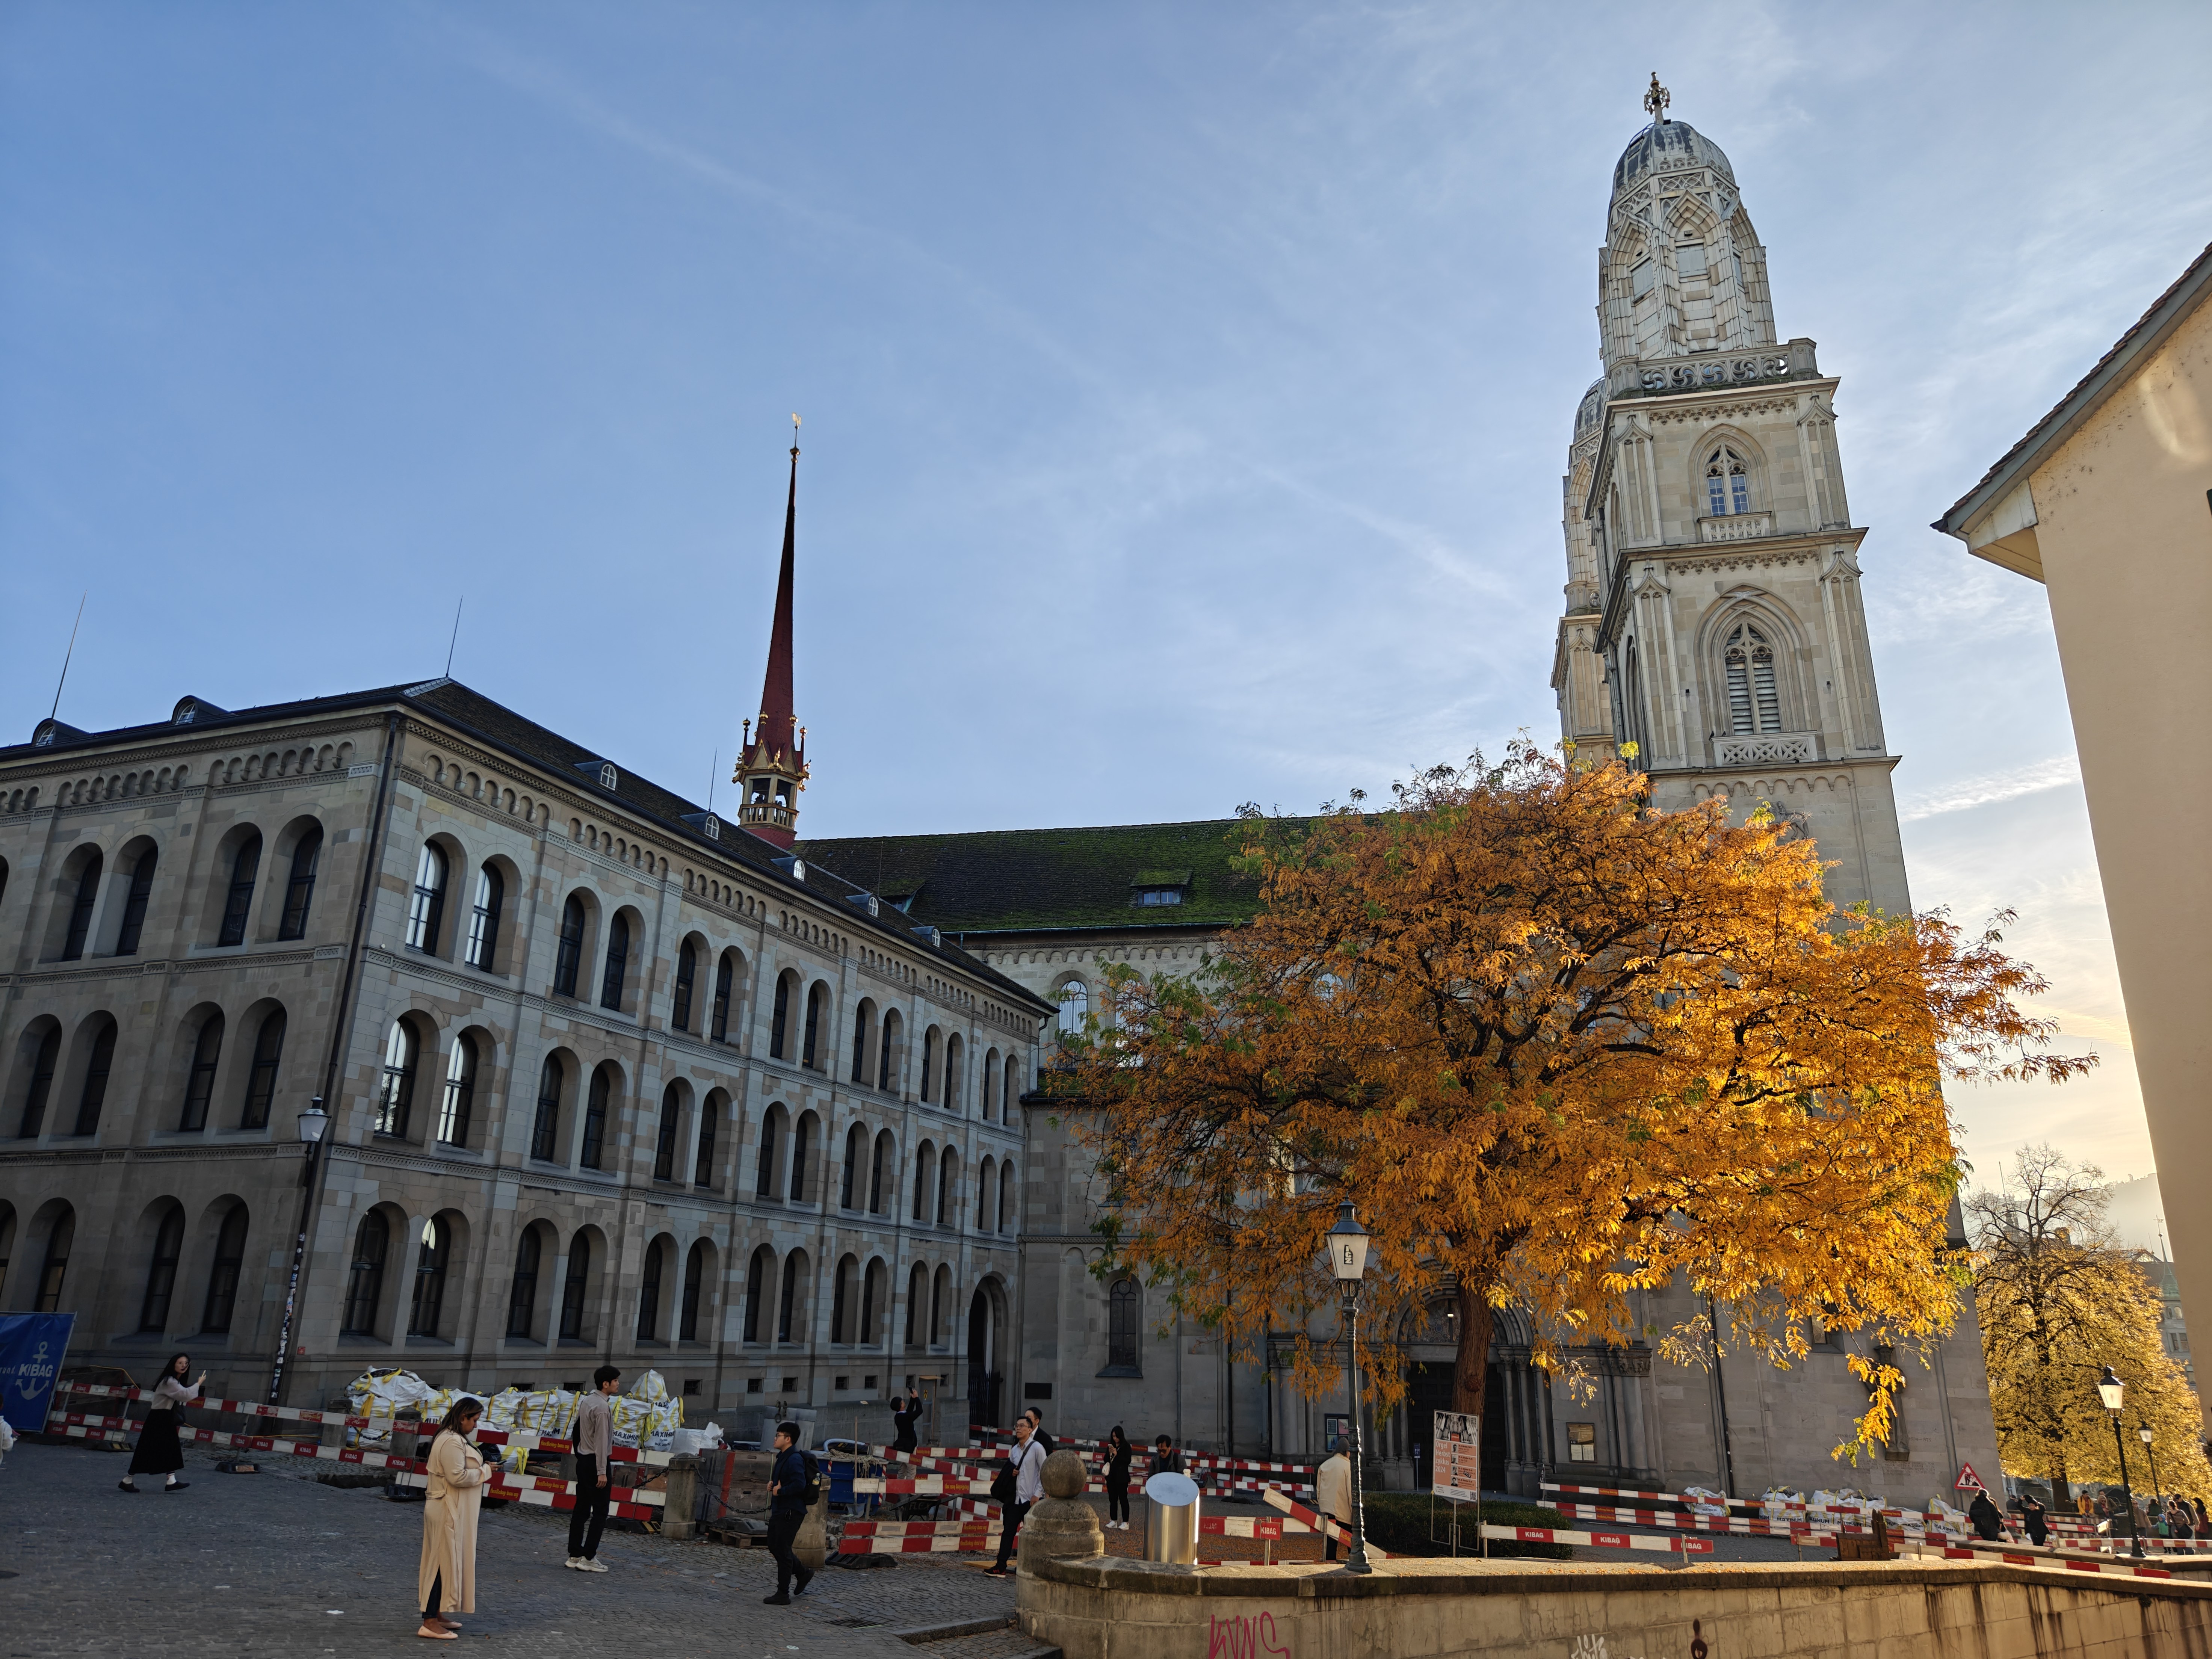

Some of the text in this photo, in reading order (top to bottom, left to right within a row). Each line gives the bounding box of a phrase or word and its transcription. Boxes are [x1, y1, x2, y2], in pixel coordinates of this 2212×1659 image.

[18, 1363, 53, 1377] KIBAG
[613, 1430, 639, 1440] MAXIMUM
[1436, 1441, 1447, 1450] Orgel
